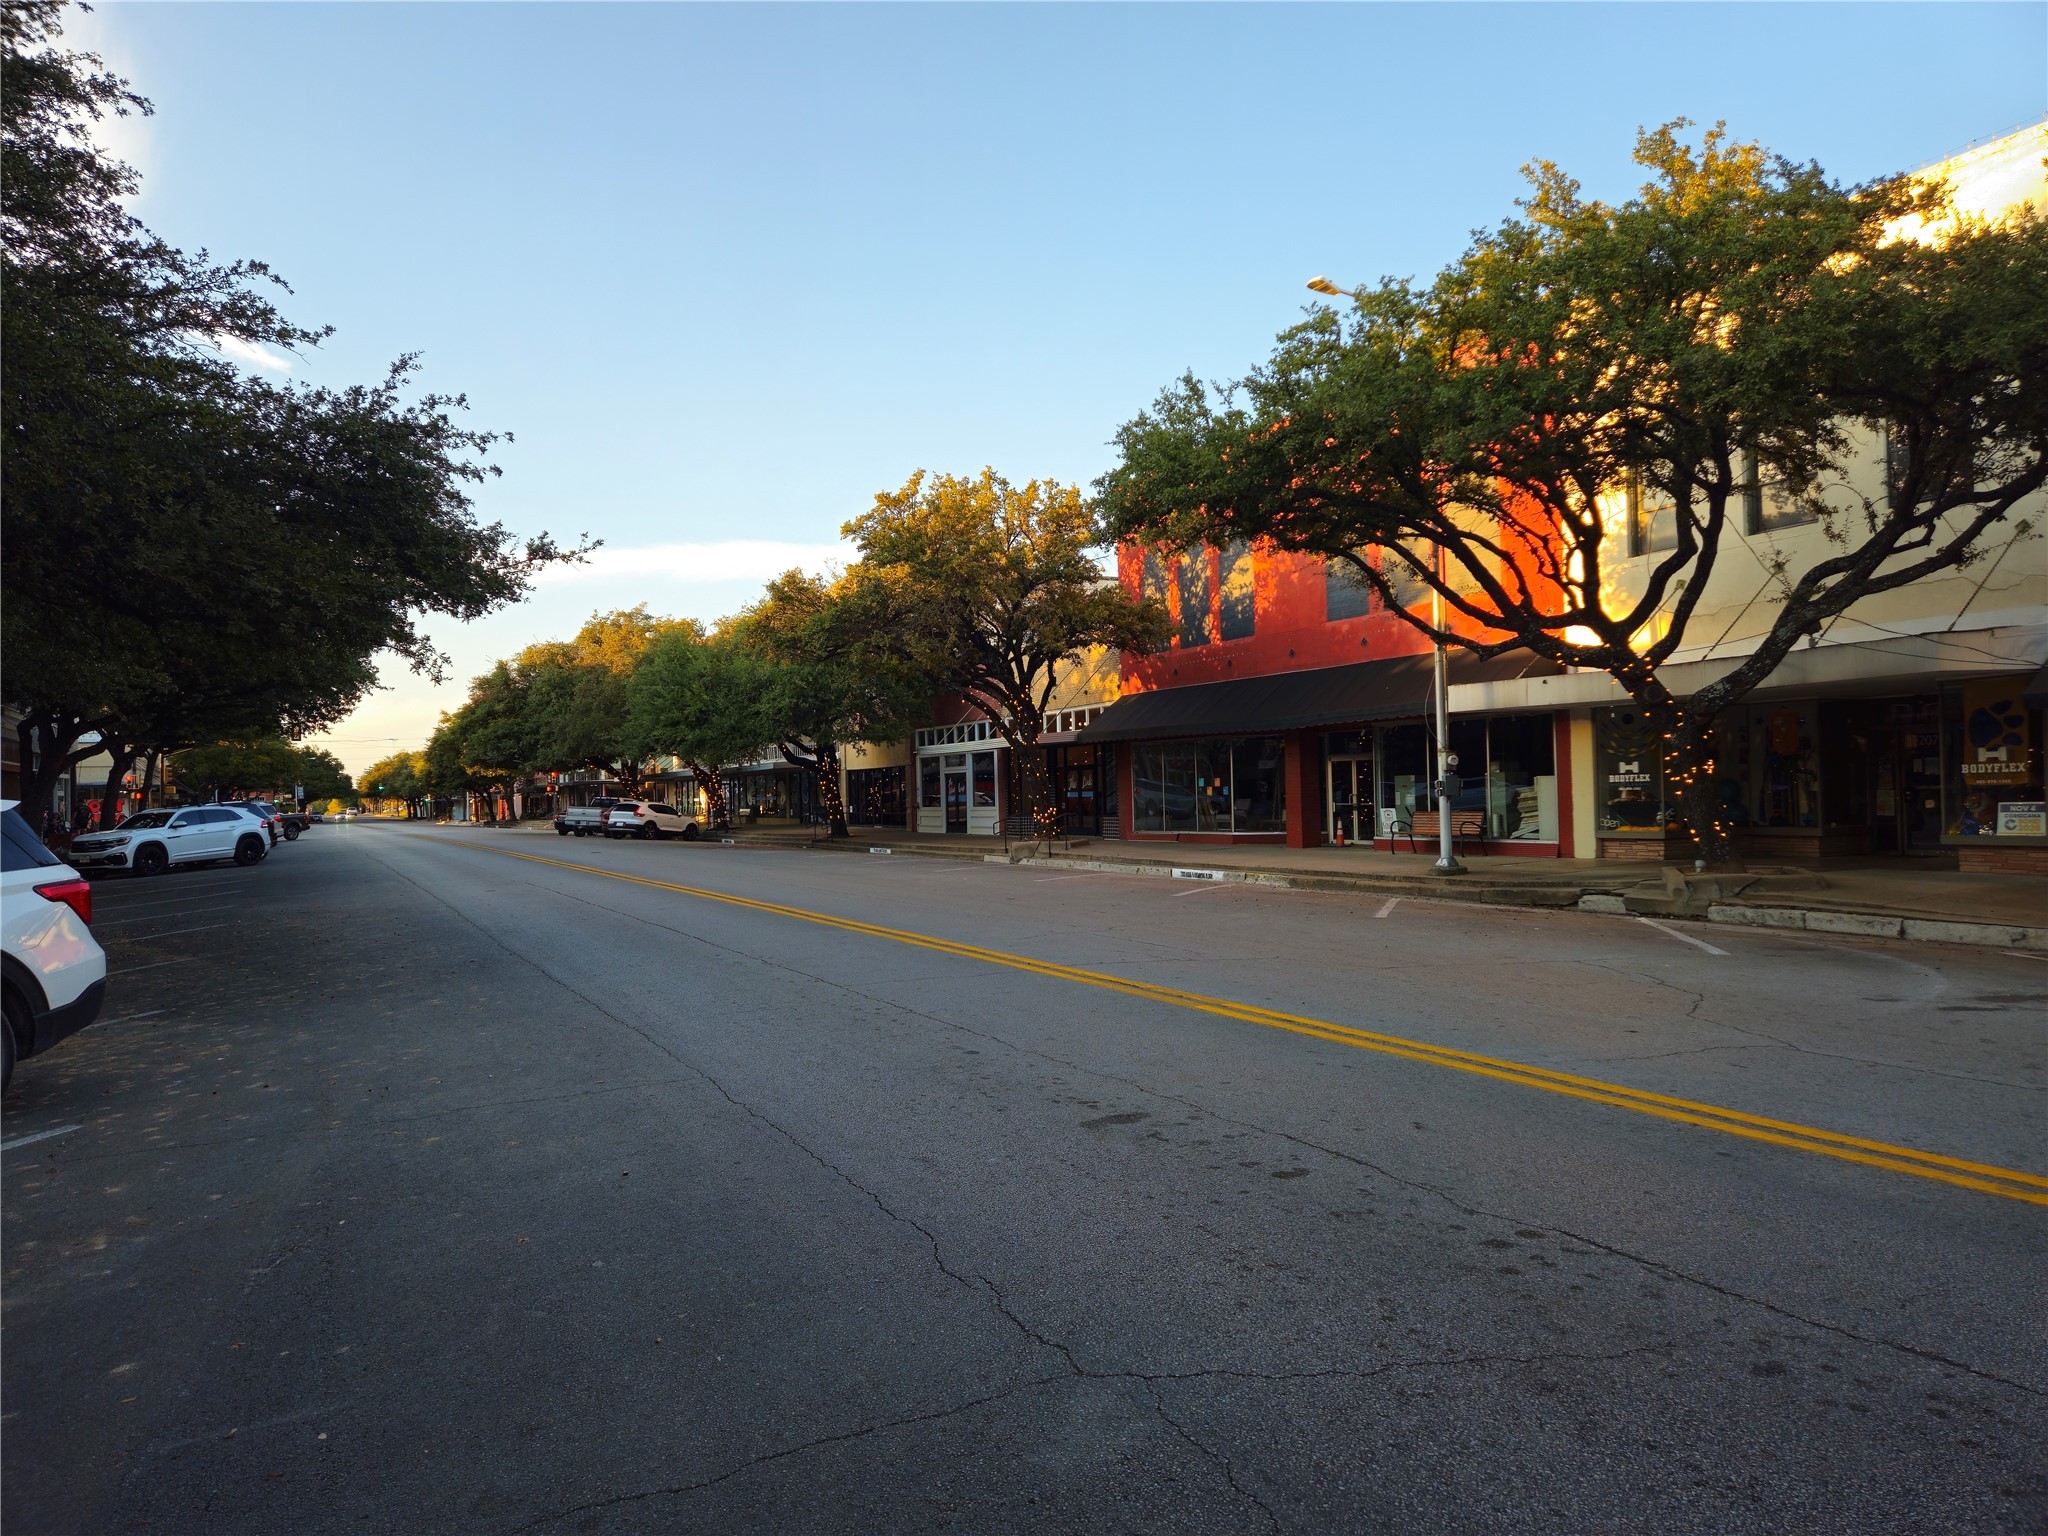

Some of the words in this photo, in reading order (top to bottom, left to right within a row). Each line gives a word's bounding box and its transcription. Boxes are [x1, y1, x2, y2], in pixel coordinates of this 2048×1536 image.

[1919, 735, 1938, 746] 207
[1961, 762, 2026, 774] BODYFLEX
[1608, 774, 1651, 783] BODYFLEX
[1600, 818, 1621, 830] open
